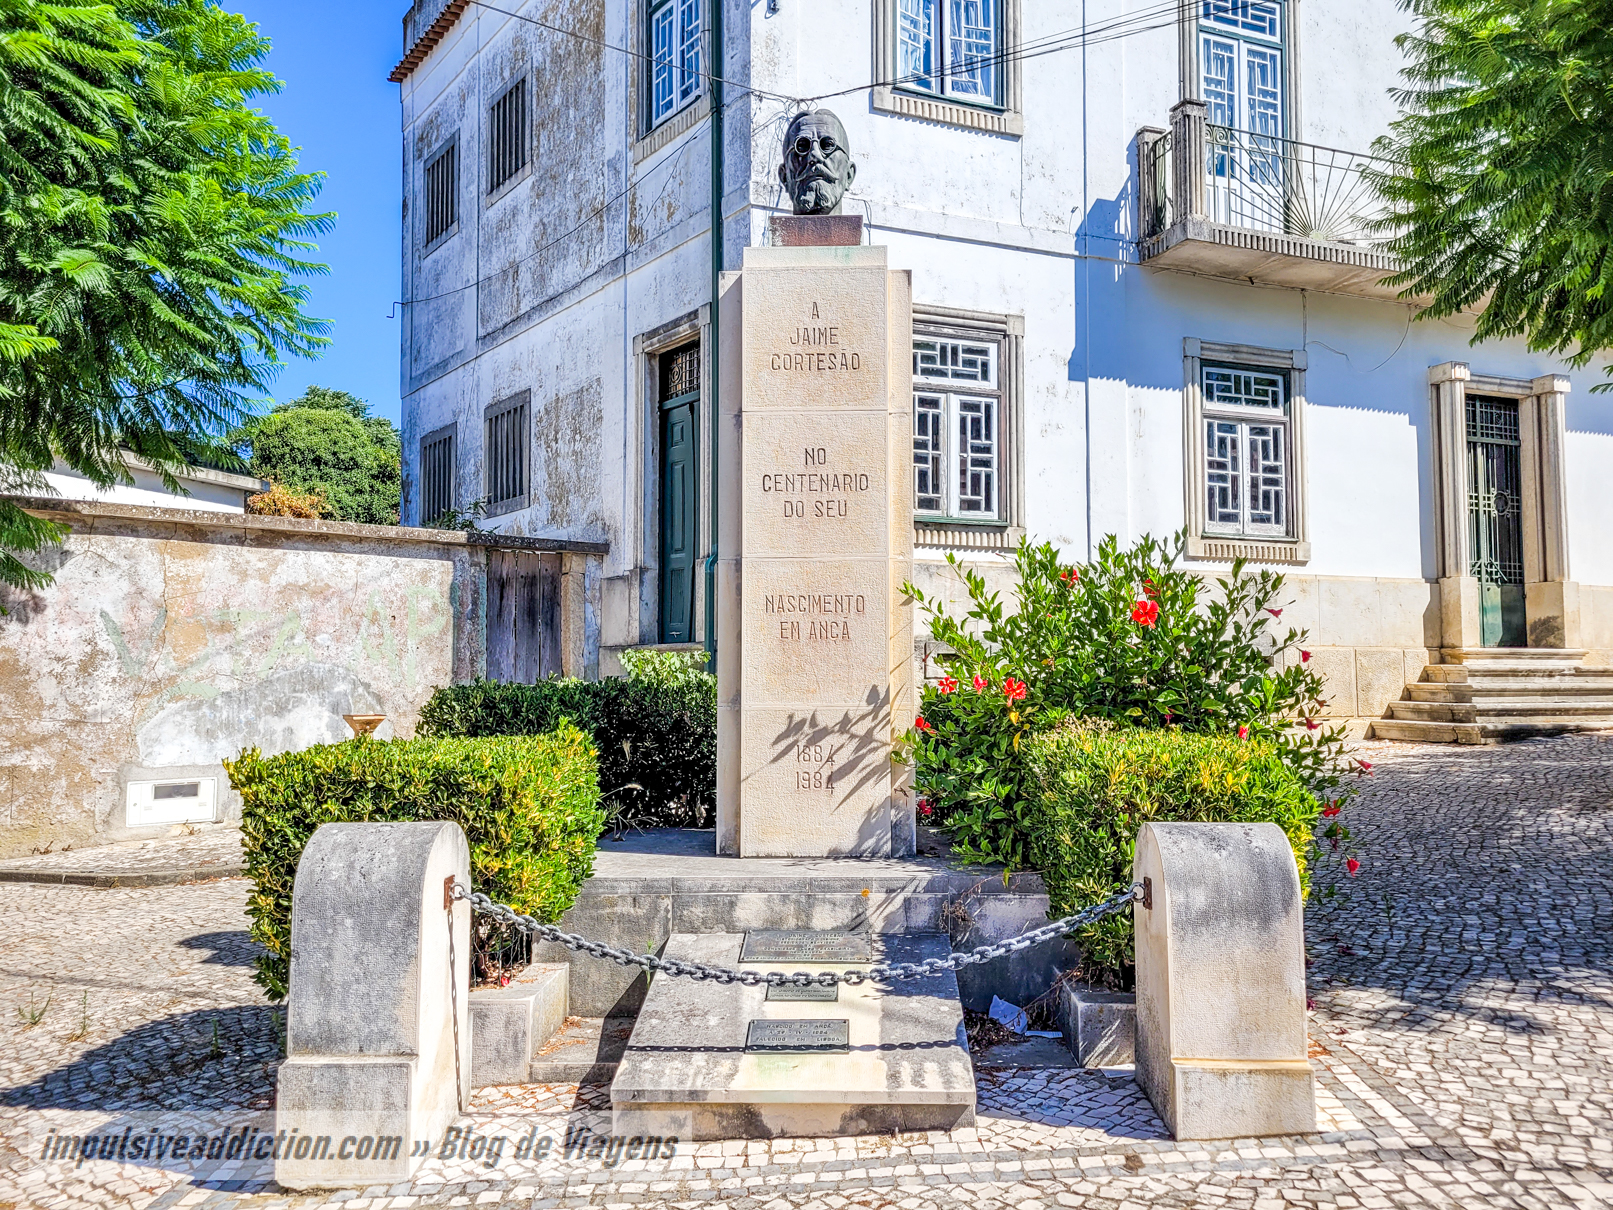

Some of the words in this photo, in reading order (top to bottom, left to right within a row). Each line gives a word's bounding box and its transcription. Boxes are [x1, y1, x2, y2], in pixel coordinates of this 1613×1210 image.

[811, 301, 820, 320] A
[790, 327, 839, 346] JAIME
[770, 348, 860, 371] CORTESÃO
[804, 447, 827, 466] NO
[762, 473, 870, 493] CENTENARIO
[784, 499, 805, 518] DO
[814, 499, 848, 518] SEU
[765, 594, 865, 614] NASCIMENTO
[780, 620, 800, 640] EM
[796, 744, 836, 767] 1884
[796, 771, 836, 795] 1984
